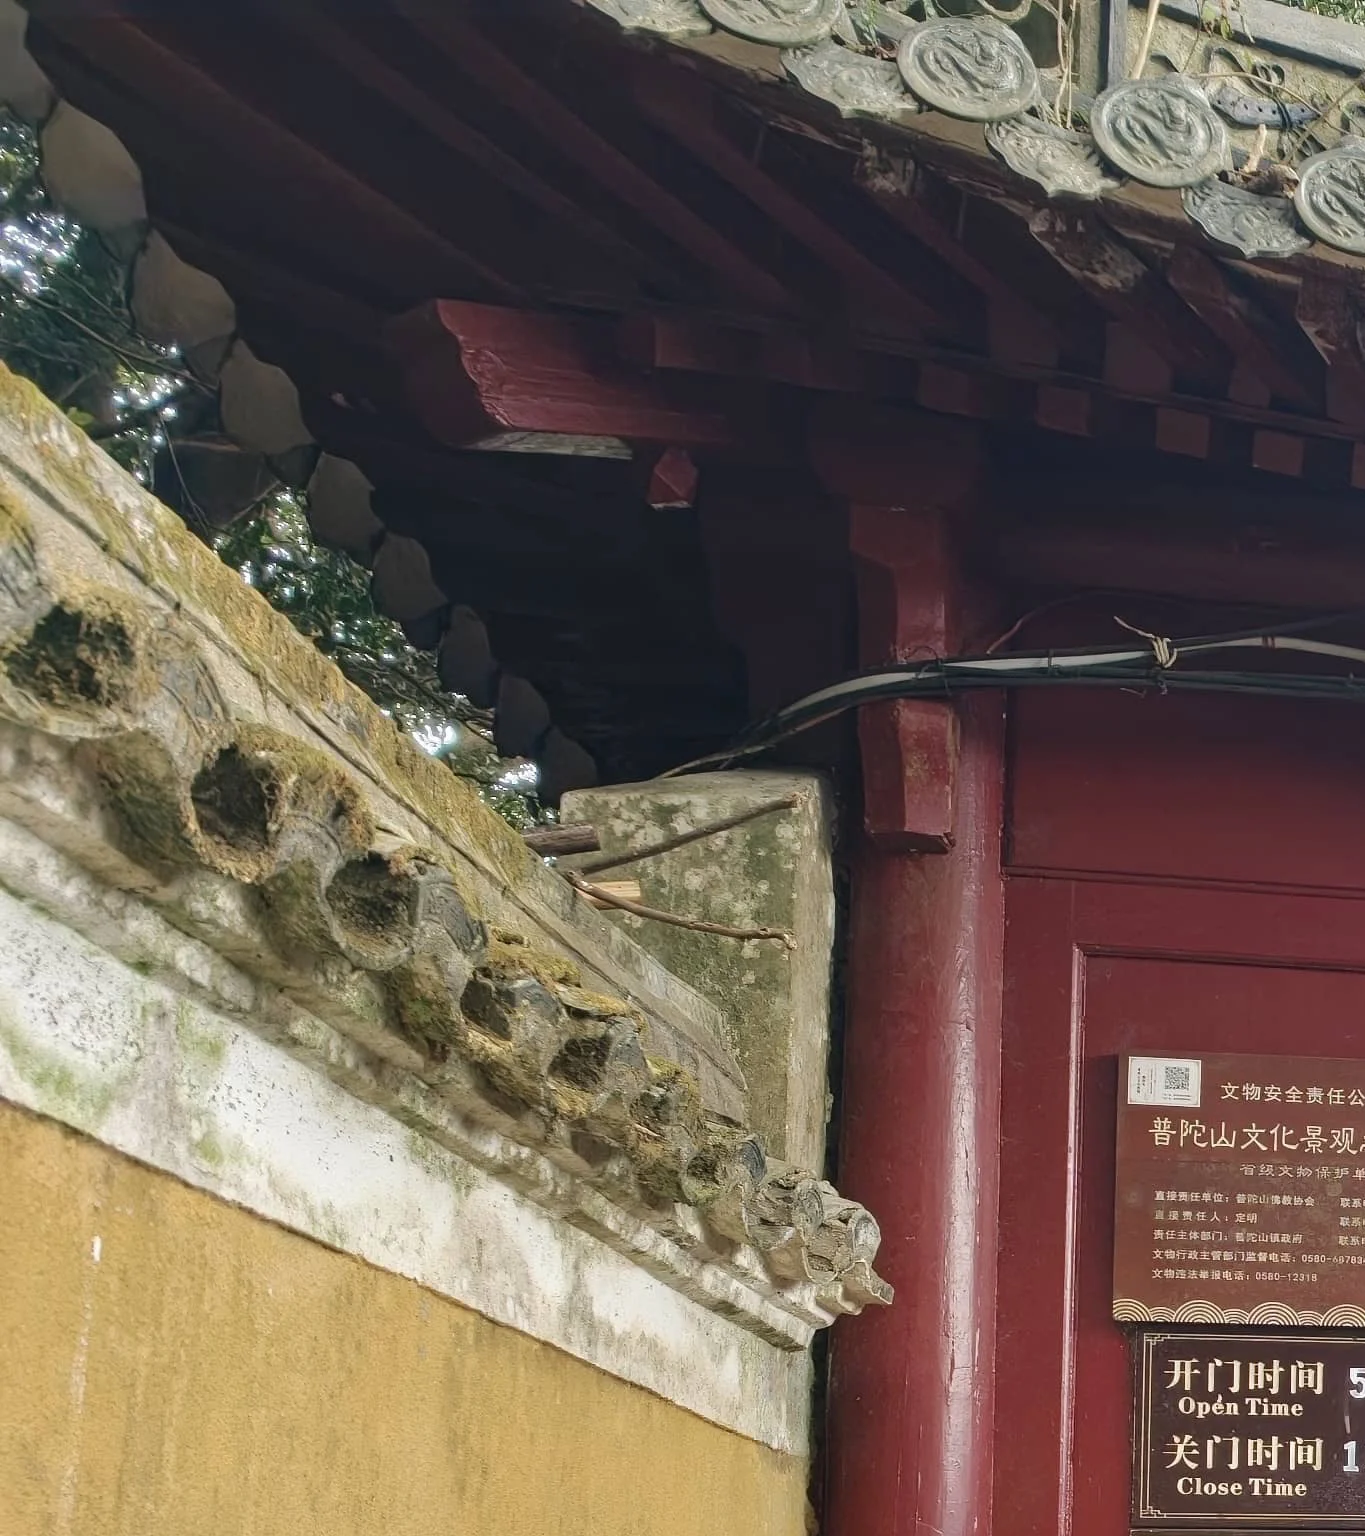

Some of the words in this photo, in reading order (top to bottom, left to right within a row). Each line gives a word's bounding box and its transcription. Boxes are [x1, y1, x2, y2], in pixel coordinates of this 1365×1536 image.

[1163, 1358, 1325, 1394] 开门时间
[1178, 1396, 1239, 1418] Open
[1245, 1397, 1304, 1417] Time
[1162, 1434, 1324, 1471] 关门时间
[1176, 1477, 1243, 1497] Close
[1248, 1478, 1307, 1497] Time
